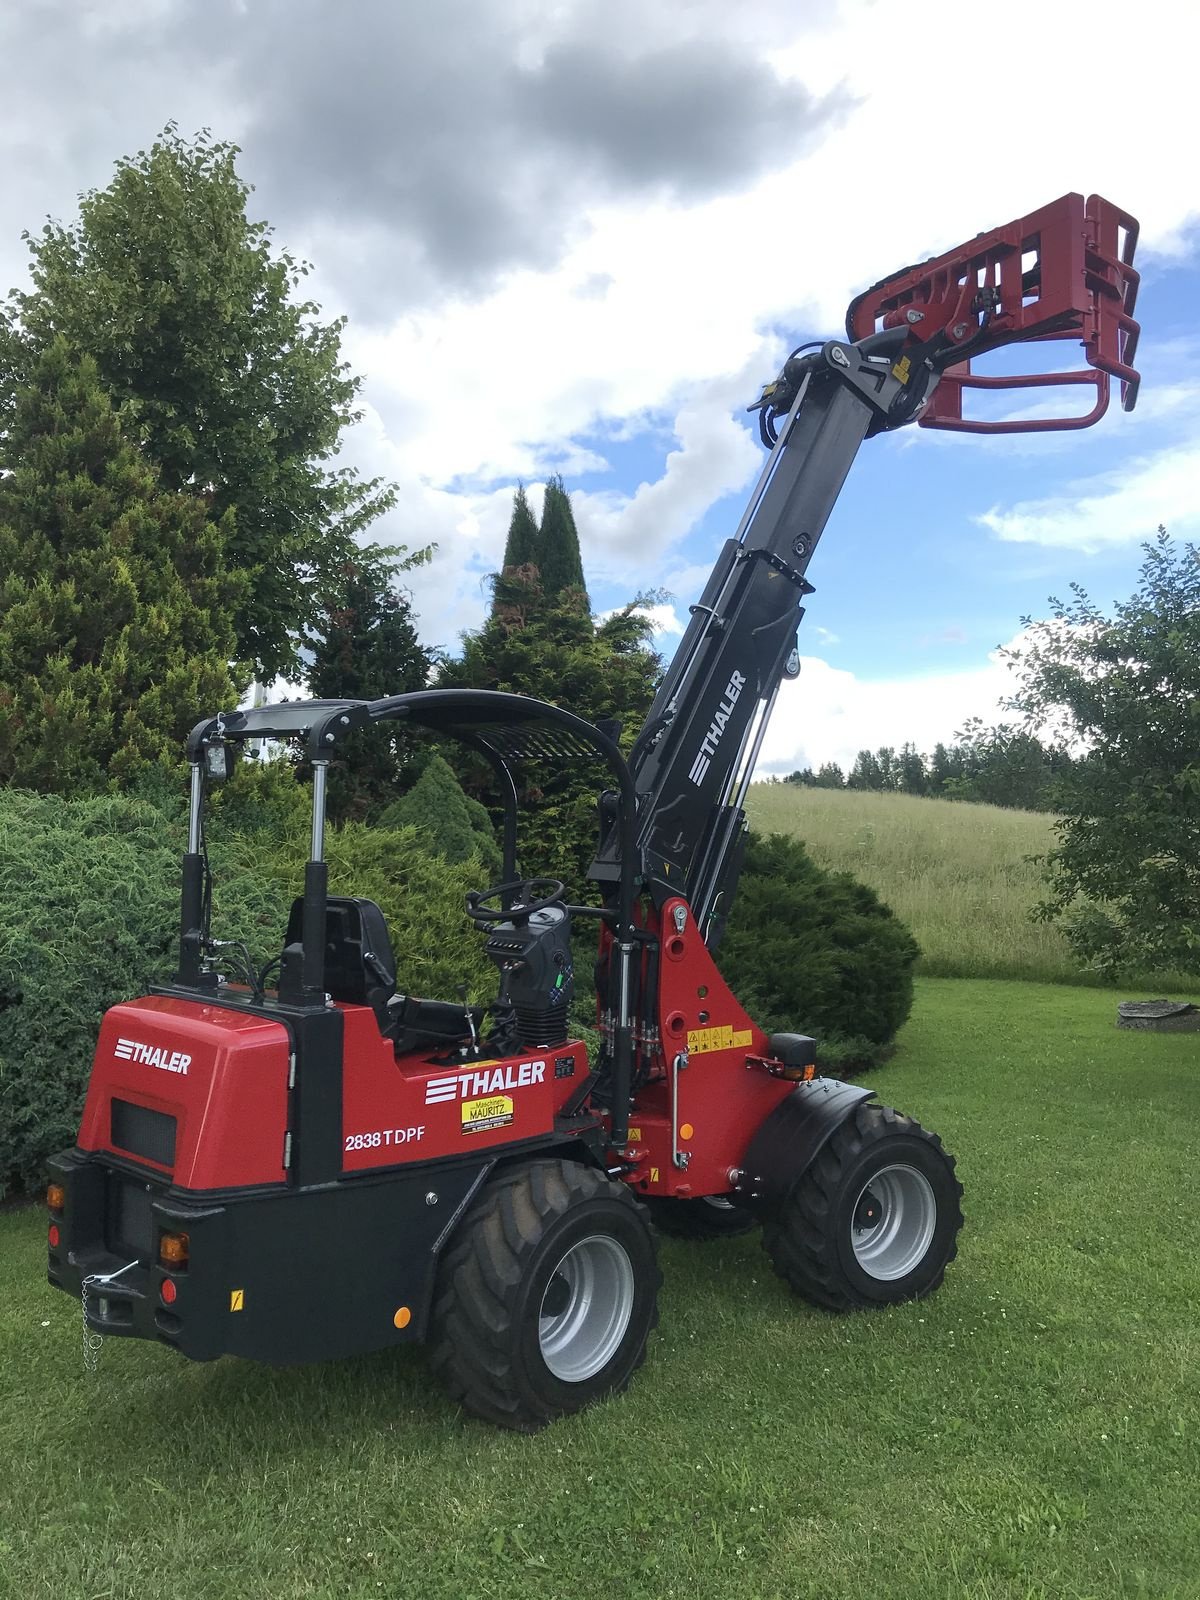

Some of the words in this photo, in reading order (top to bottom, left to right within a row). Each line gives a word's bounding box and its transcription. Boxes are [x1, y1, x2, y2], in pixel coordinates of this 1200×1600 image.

[700, 669, 747, 756] THALER
[133, 1042, 192, 1075] THALER
[458, 1060, 546, 1098] THALER
[470, 1104, 505, 1120] MAURITZ
